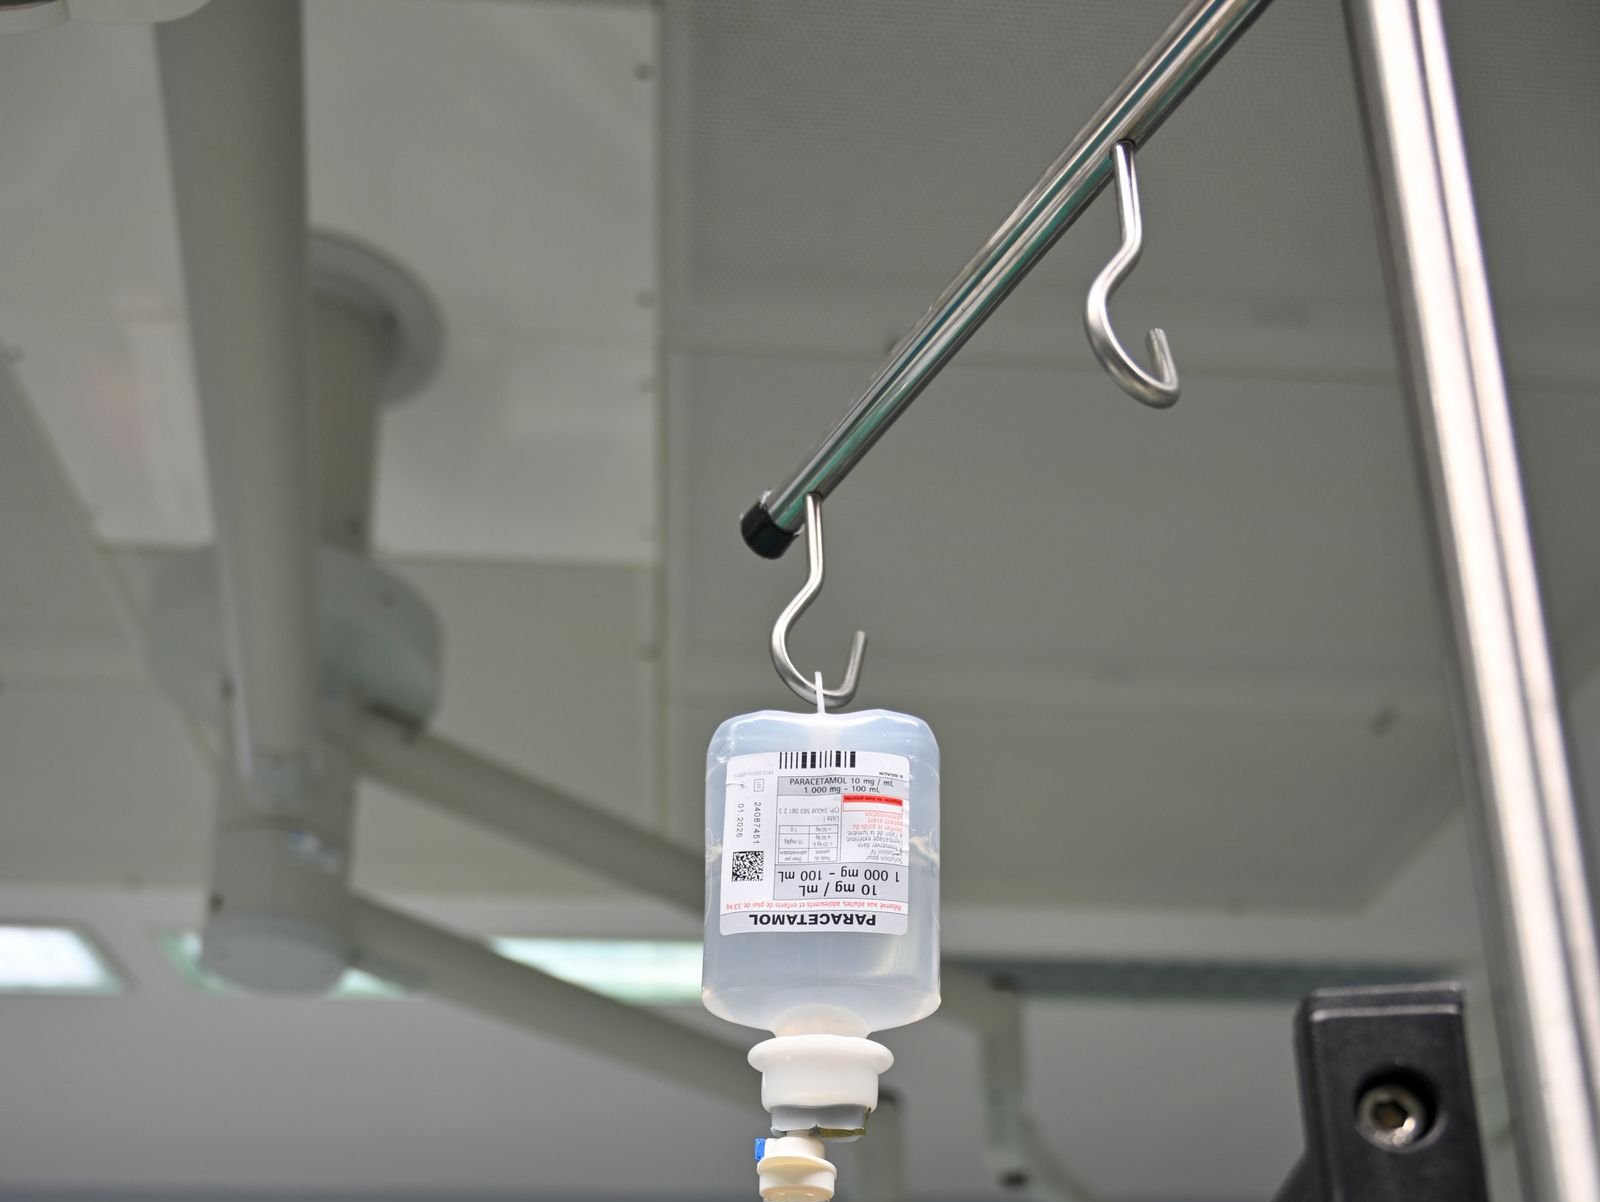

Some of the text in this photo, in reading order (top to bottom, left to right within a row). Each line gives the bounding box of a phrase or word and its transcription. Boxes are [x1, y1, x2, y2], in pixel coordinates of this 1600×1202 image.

[789, 777, 847, 786] PARACETAMOL
[830, 786, 841, 794] mg
[753, 801, 761, 844] 24087451
[777, 871, 795, 883] mL
[800, 870, 823, 882] 100
[841, 866, 859, 878] mg
[864, 869, 889, 882] 000
[895, 872, 900, 882] 1
[798, 880, 877, 897] 10 mg / mL
[749, 914, 876, 926] PARACETAMOL
